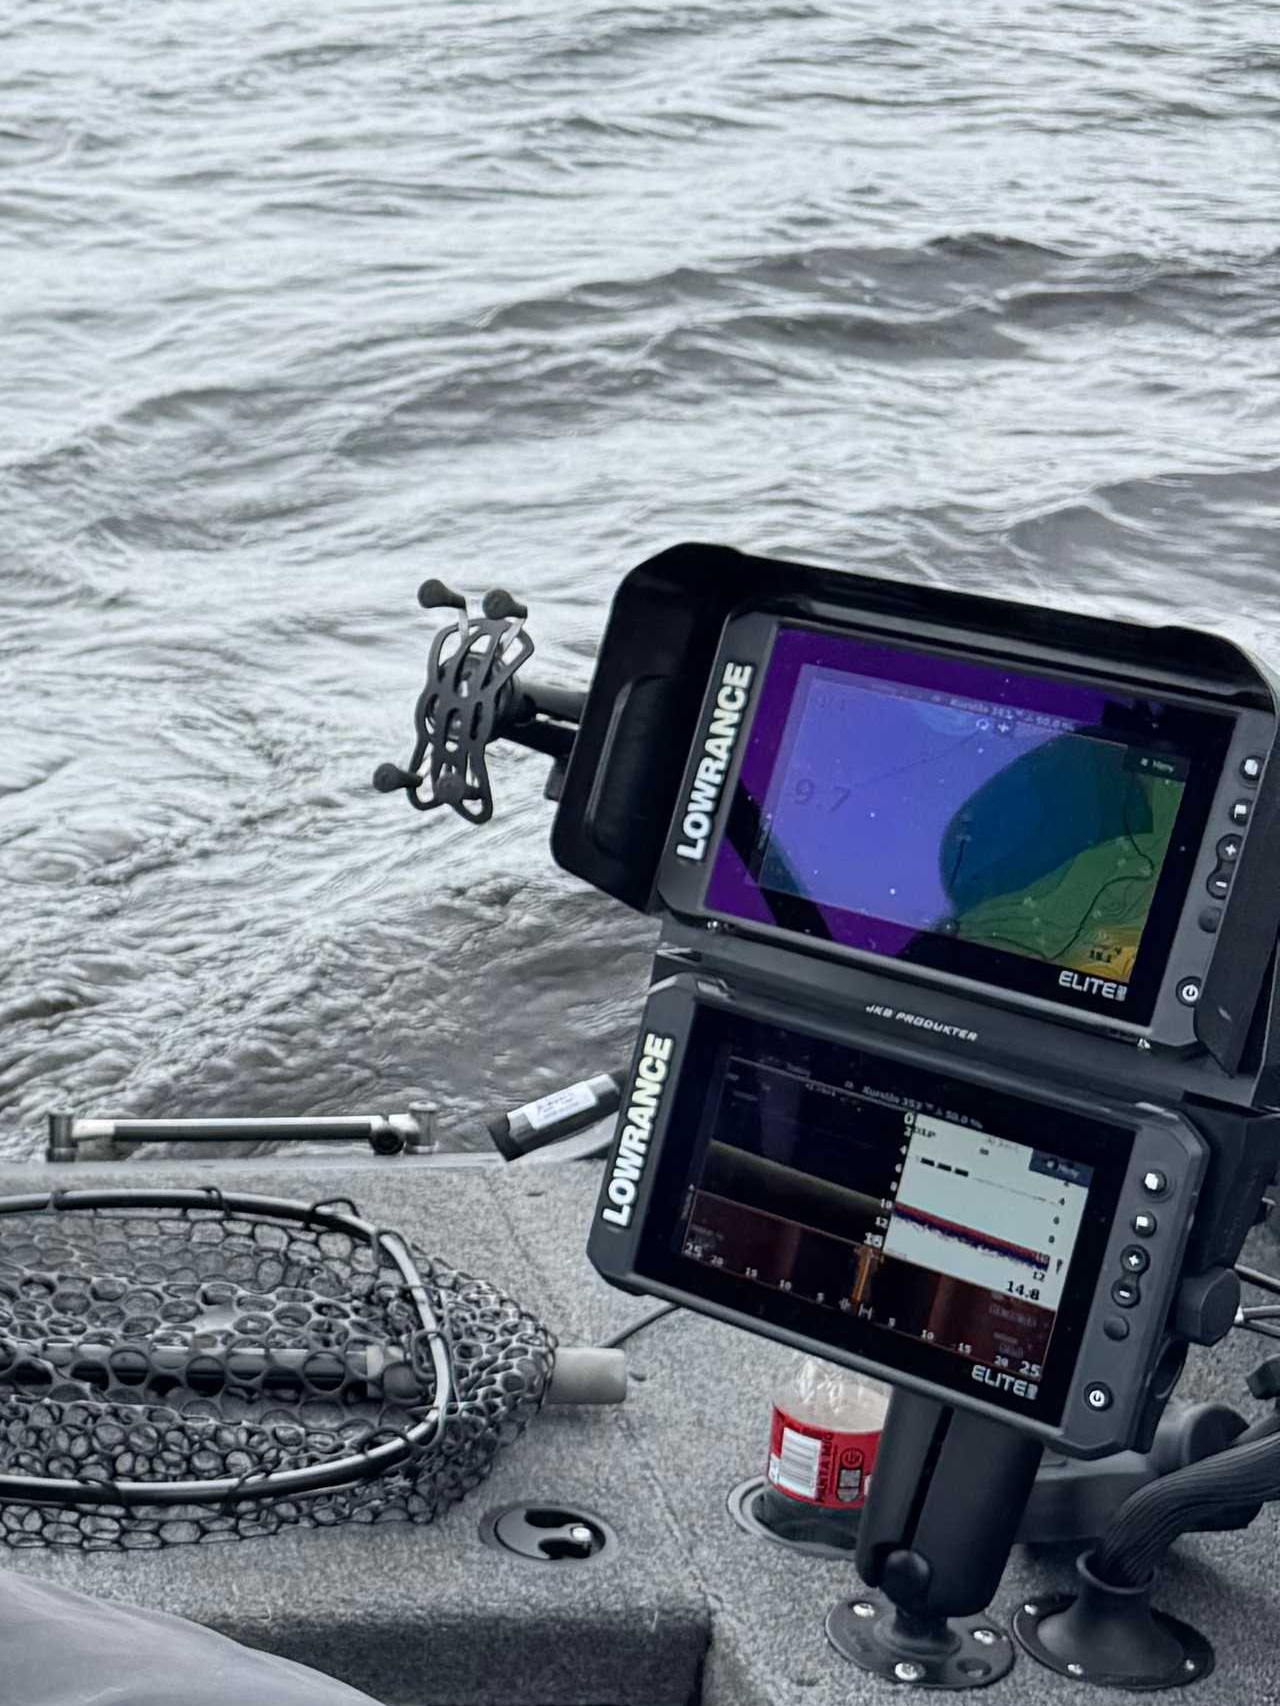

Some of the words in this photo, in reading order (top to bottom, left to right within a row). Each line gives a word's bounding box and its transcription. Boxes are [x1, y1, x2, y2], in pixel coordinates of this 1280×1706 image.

[676, 662, 754, 861] LOWRANCE
[792, 778, 851, 813] 9.7
[1058, 970, 1117, 1000] ELITE
[865, 1004, 893, 1018] JKB
[895, 1011, 978, 1042] PRODUKTER
[602, 1032, 674, 1228] LOWRANCE
[1007, 1280, 1041, 1301] 14.8
[684, 1242, 703, 1260] 25
[1019, 1360, 1042, 1378] 25
[971, 1365, 1028, 1398] ELITE
